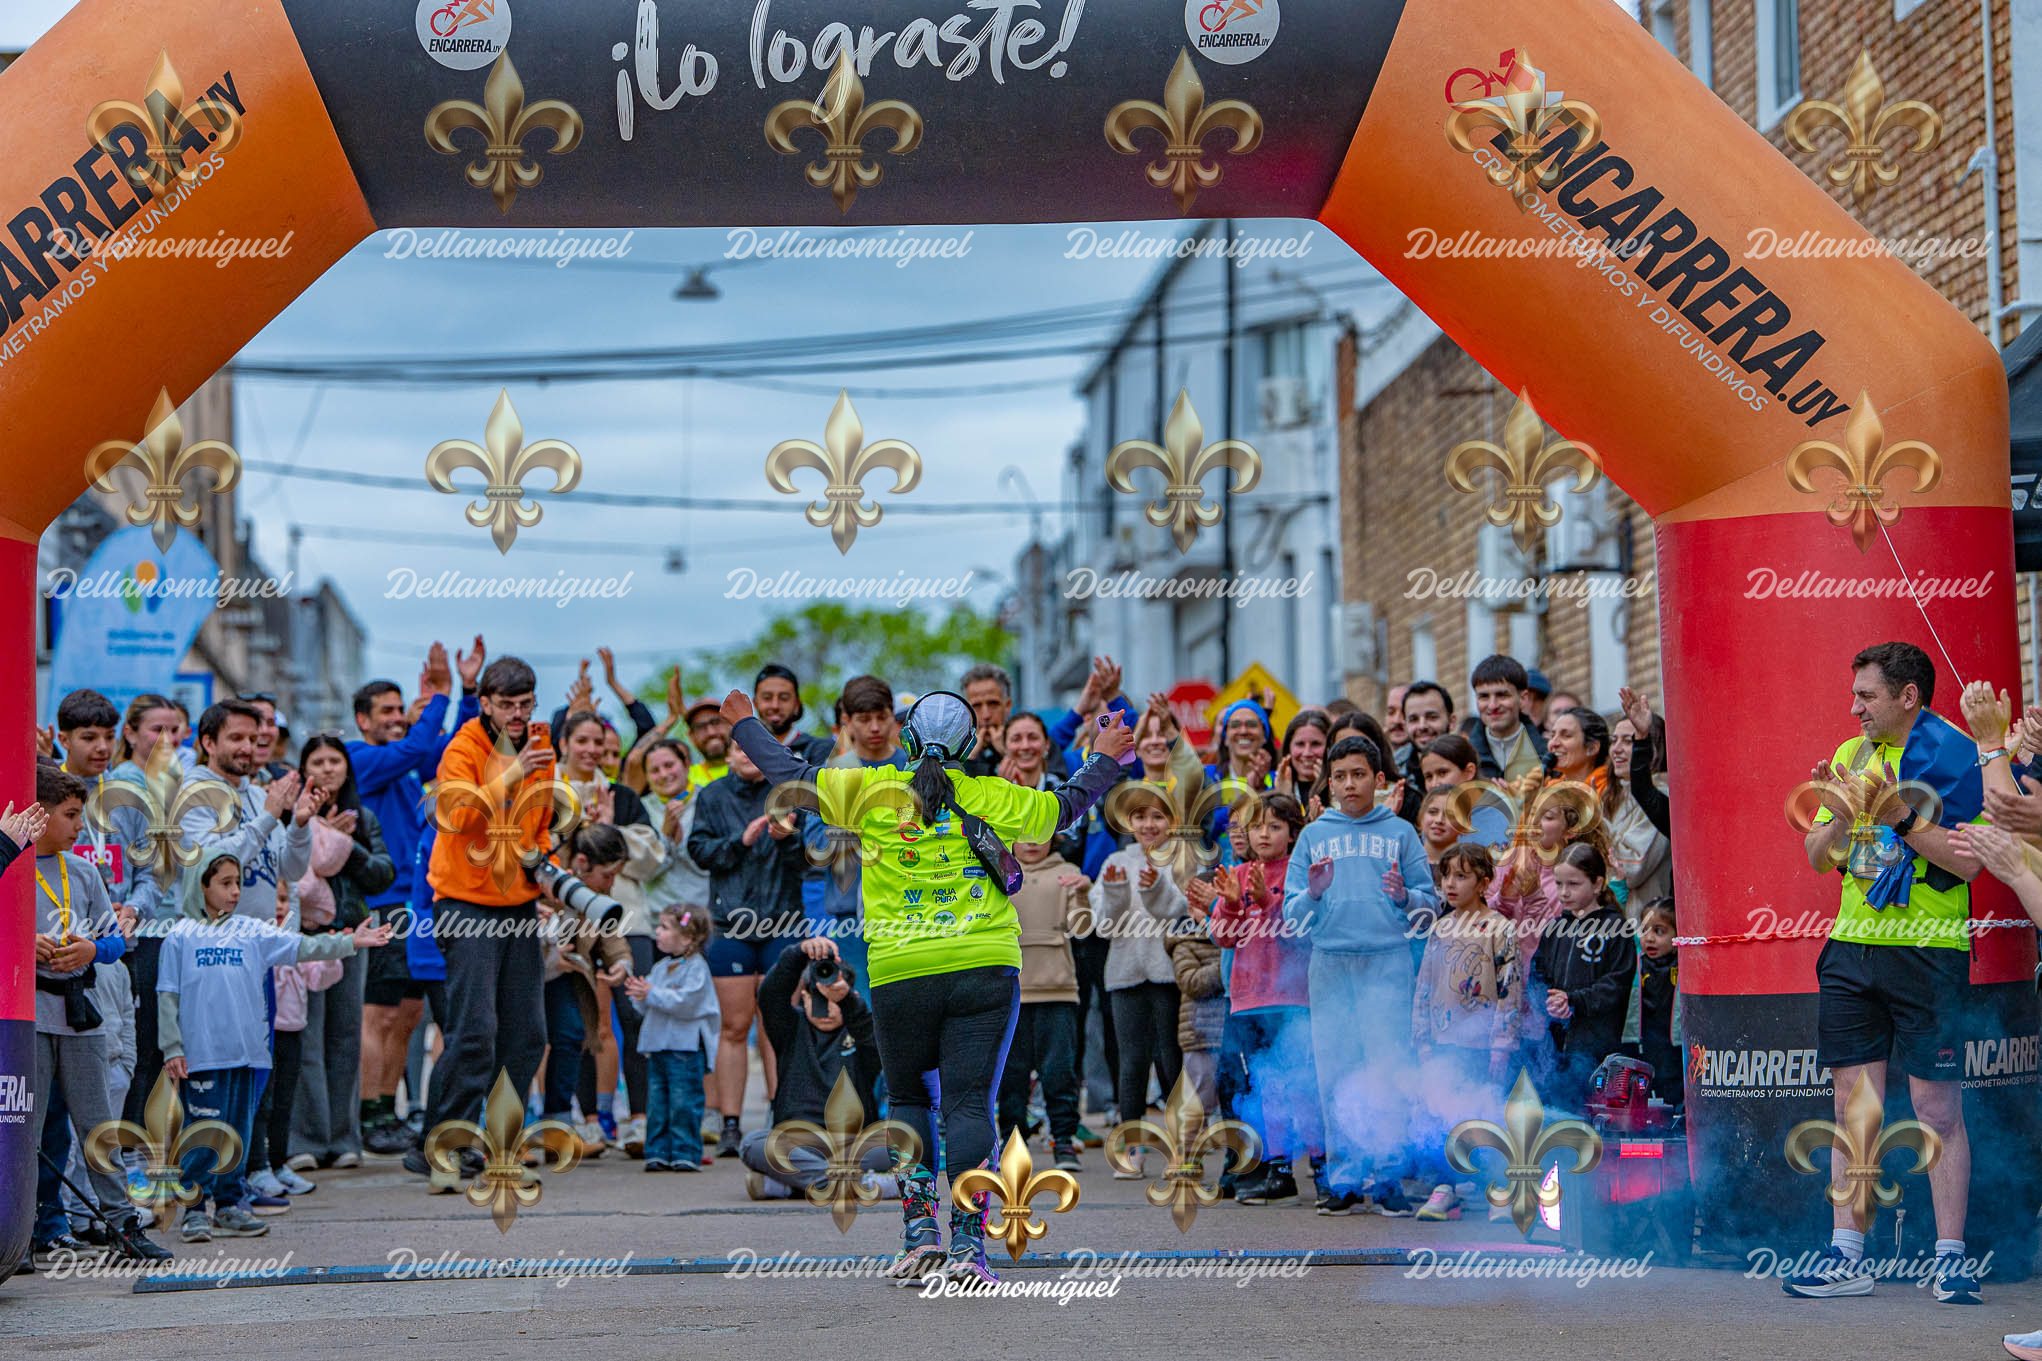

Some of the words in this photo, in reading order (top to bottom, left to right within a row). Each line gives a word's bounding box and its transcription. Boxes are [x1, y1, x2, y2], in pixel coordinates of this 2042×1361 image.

[428, 38, 502, 53] ENCARRERA.UY
[1198, 33, 1271, 48] ENCARRERA.UY
[0, 70, 247, 337] ARRERA.UY
[93, 256, 109, 274] Y
[109, 151, 226, 264] DIFUNDIMOS
[1472, 147, 1639, 298] CRONOMETRAMOS
[1636, 291, 1656, 309] Y
[1648, 305, 1769, 412] DIFUNDIMOS
[1489, 107, 1851, 428] ENCARRERA.UY
[1310, 831, 1400, 864] MALIBU
[935, 895, 958, 904] PURA
[195, 947, 244, 957] PROFIT
[197, 956, 227, 967] RUN
